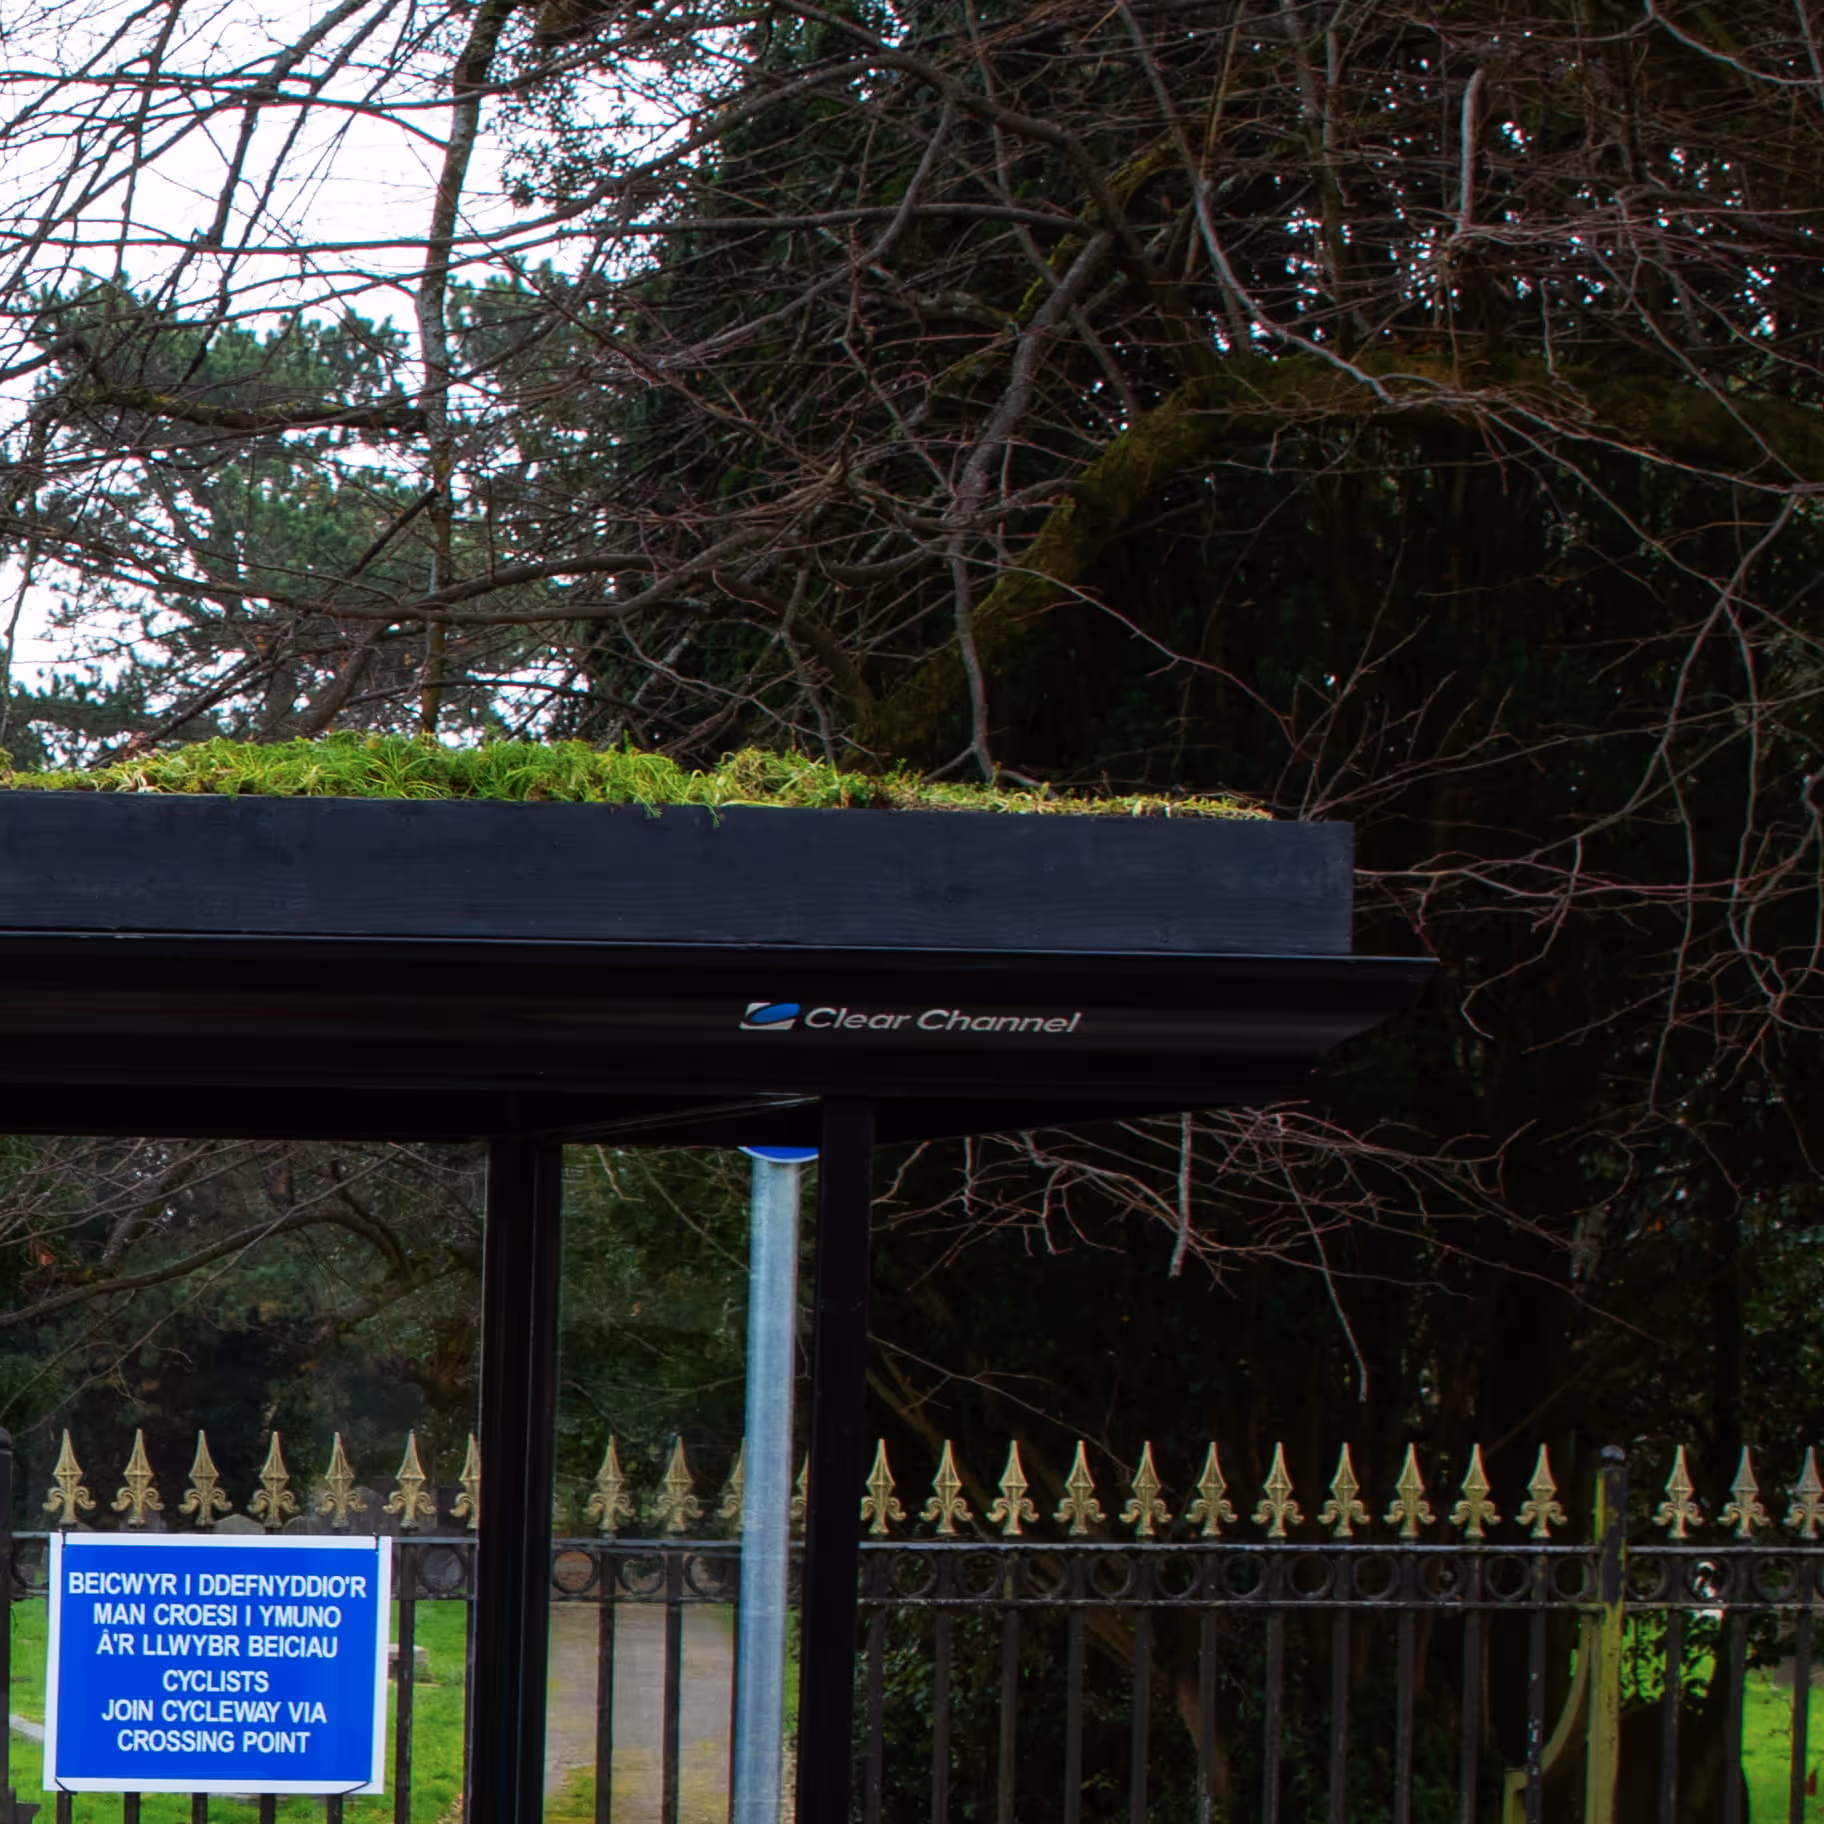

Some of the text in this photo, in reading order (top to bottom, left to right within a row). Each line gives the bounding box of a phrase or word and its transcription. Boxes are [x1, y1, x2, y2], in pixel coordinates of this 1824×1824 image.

[804, 1007, 1082, 1033] Clear Channel
[68, 1571, 367, 1598] BEICWYR I DDEFNYDDIO'R
[93, 1603, 341, 1628] MAN CROESI I YMUNO
[96, 1628, 338, 1658] Â'R LLWYBR BEICIAU
[163, 1669, 270, 1693] CYCLISTS
[101, 1699, 327, 1724] JOIN CYCLEWAY VIA
[117, 1729, 311, 1753] CROSSING POINT
